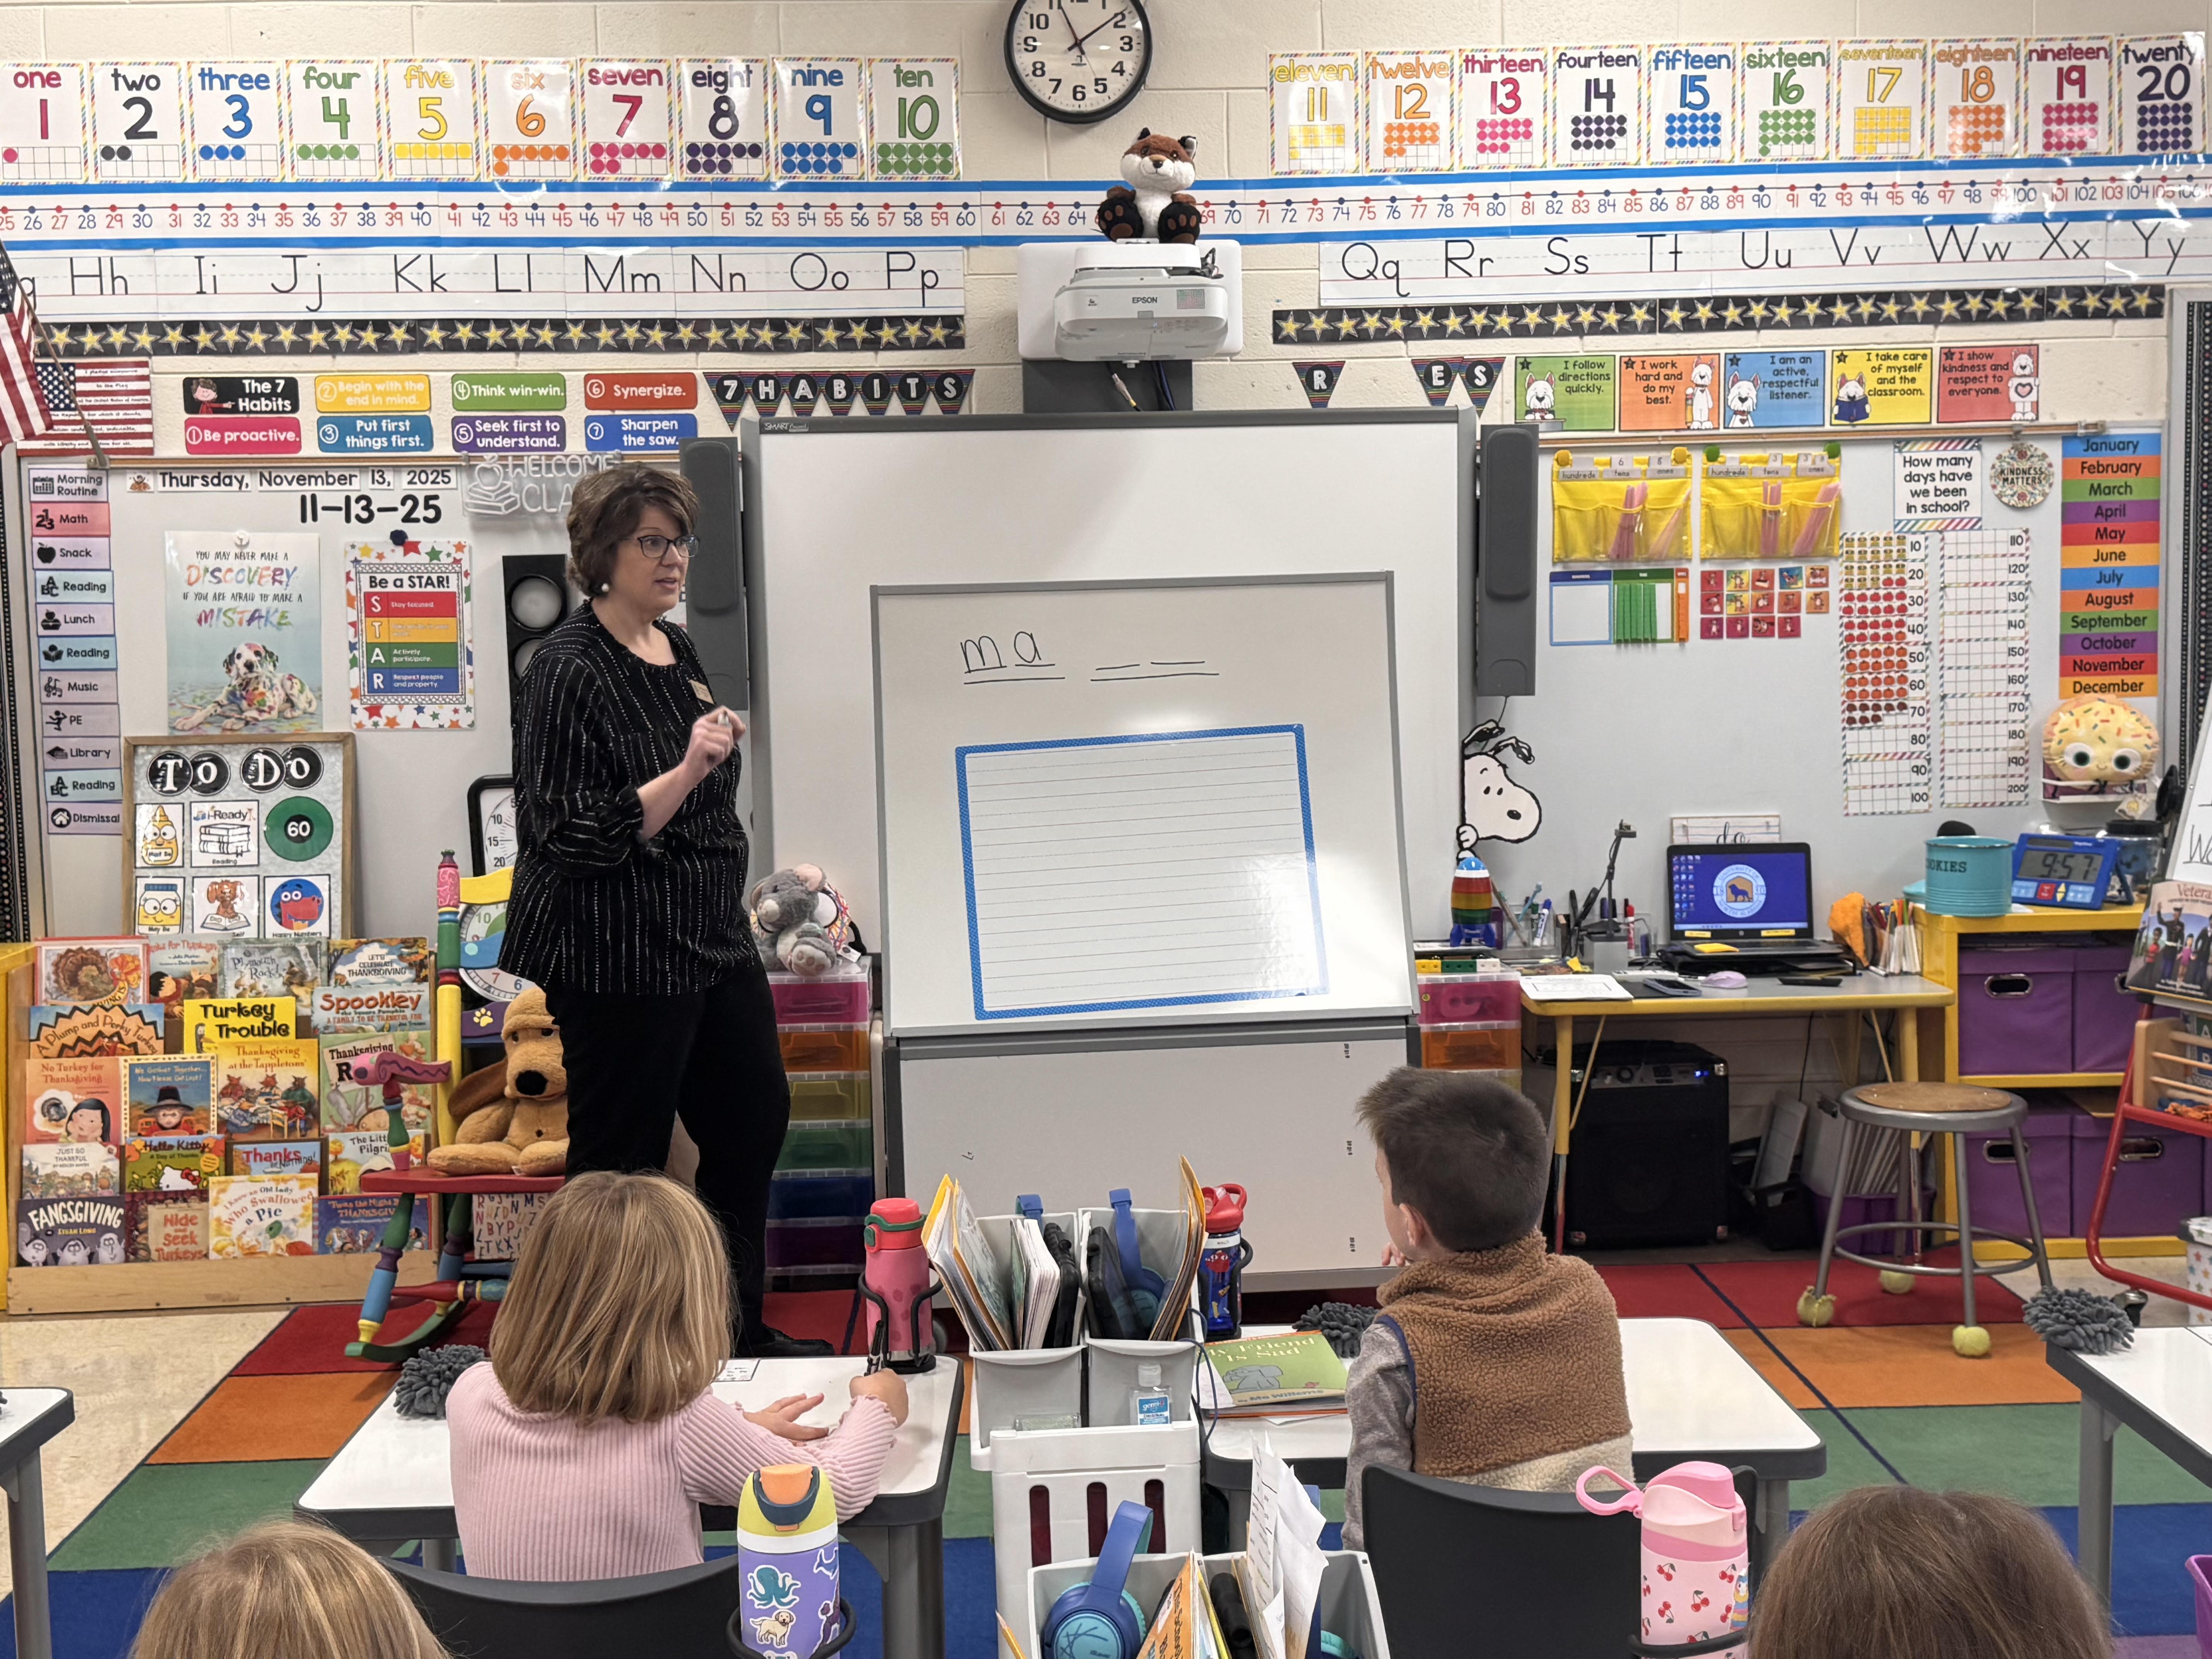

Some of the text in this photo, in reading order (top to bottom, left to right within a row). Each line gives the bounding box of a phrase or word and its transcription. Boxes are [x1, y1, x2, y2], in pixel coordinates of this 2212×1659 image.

[1030, 14, 1049, 29] 10
[1746, 48, 1826, 69] sixteen
[1936, 45, 2015, 64] eighteen
[2028, 44, 2110, 61] nineteen
[2122, 41, 2198, 66] twenty
[1369, 56, 1450, 80] twelve
[1463, 53, 1544, 74] thirteen
[1556, 52, 1638, 69] fourteen
[1652, 50, 1731, 71] fifteen
[588, 65, 663, 87] seven
[791, 64, 843, 88] nine
[893, 64, 933, 88] ten
[1032, 61, 1046, 77] 8
[1111, 61, 1125, 76] 4
[1274, 60, 1355, 82] eleven
[13, 69, 62, 89] one
[111, 68, 161, 91] two
[198, 67, 271, 91] three
[303, 65, 361, 90] four
[404, 65, 455, 88] five
[692, 65, 753, 94] eight
[2137, 65, 2191, 102] 20
[1585, 78, 1616, 112] 14
[1772, 71, 1804, 106] 16
[123, 96, 158, 140] 2
[612, 94, 642, 138] 7
[898, 94, 939, 140] 10
[2075, 186, 2097, 202] 102
[1546, 195, 1719, 215] 82 88
[132, 212, 431, 228] 30 40
[606, 211, 922, 227] 47 58
[1016, 211, 1033, 225] 62
[1741, 225, 2011, 270] Uu Ww
[70, 254, 448, 296] Hh Kk
[1341, 238, 1589, 297] Qq Ss
[585, 251, 939, 307] Mm Oo Pp
[1866, 352, 1928, 361] I take care
[1564, 360, 1606, 370] I follow
[1871, 364, 1923, 374] of myself
[242, 379, 285, 393] The 7
[1877, 376, 1916, 385] and the
[472, 385, 564, 397] Think win-win.
[614, 385, 686, 399] Synergize.
[724, 380, 737, 399] 7
[1868, 387, 1925, 397] classroom.
[239, 398, 292, 411] Habits
[356, 419, 410, 432] Put first
[475, 419, 560, 433] Seek first to
[621, 419, 678, 432] Sharpen
[204, 428, 300, 445] Be proactive.
[345, 434, 424, 449] things first.
[476, 435, 560, 448] understand.
[623, 434, 679, 446] the saw.
[2083, 438, 2139, 454] January
[1903, 456, 1973, 469] How many
[2081, 461, 2142, 476] February
[160, 469, 452, 490] Thursday, November 13, 2025
[1904, 471, 1972, 485] days have
[2000, 467, 2044, 477] KINDNESS
[57, 474, 103, 486] Morning
[2002, 475, 2042, 485] MATTERS
[57, 487, 98, 496] Routine
[1910, 486, 1966, 498] we been
[2089, 482, 2133, 496] March
[1921, 500, 1970, 514] school?
[2094, 504, 2126, 518] April
[60, 515, 88, 524] Math
[2010, 535, 2023, 546] 110
[2095, 527, 2125, 542] May
[60, 548, 92, 558] Snack
[1910, 541, 1921, 551] 10
[2093, 549, 2126, 562] June
[186, 565, 298, 590] DISCOVERY
[369, 575, 450, 589] Be a STAR!
[2096, 570, 2123, 586] July
[64, 582, 106, 593] Reading
[2085, 592, 2133, 608] August
[64, 614, 95, 624] Lunch
[196, 607, 292, 630] MISTAKE
[2071, 614, 2147, 631] September
[2081, 636, 2136, 650] October
[2073, 658, 2144, 673] November
[68, 682, 98, 691] Music
[2073, 680, 2143, 694] December
[1910, 706, 1925, 717] 70
[70, 716, 82, 725] PE
[70, 749, 110, 759] Library
[1911, 792, 1928, 802] 100
[287, 822, 311, 837] 60
[488, 837, 499, 846] 15
[2177, 884, 2212, 899] Vetera
[320, 991, 424, 1013] Spookley
[199, 1002, 276, 1022] Turkey
[81, 1016, 100, 1029] and
[132, 1026, 158, 1054] Turkey
[215, 1019, 290, 1039] Trouble
[236, 1046, 300, 1059] Thanksgiving
[41, 1063, 104, 1074] No Turkey for
[43, 1074, 102, 1084] Thanksgiving
[242, 1148, 301, 1164] Thanks
[27, 1201, 124, 1231] FANGSGIVING
[257, 1207, 283, 1221] Pie
[163, 1231, 198, 1246] Seek
